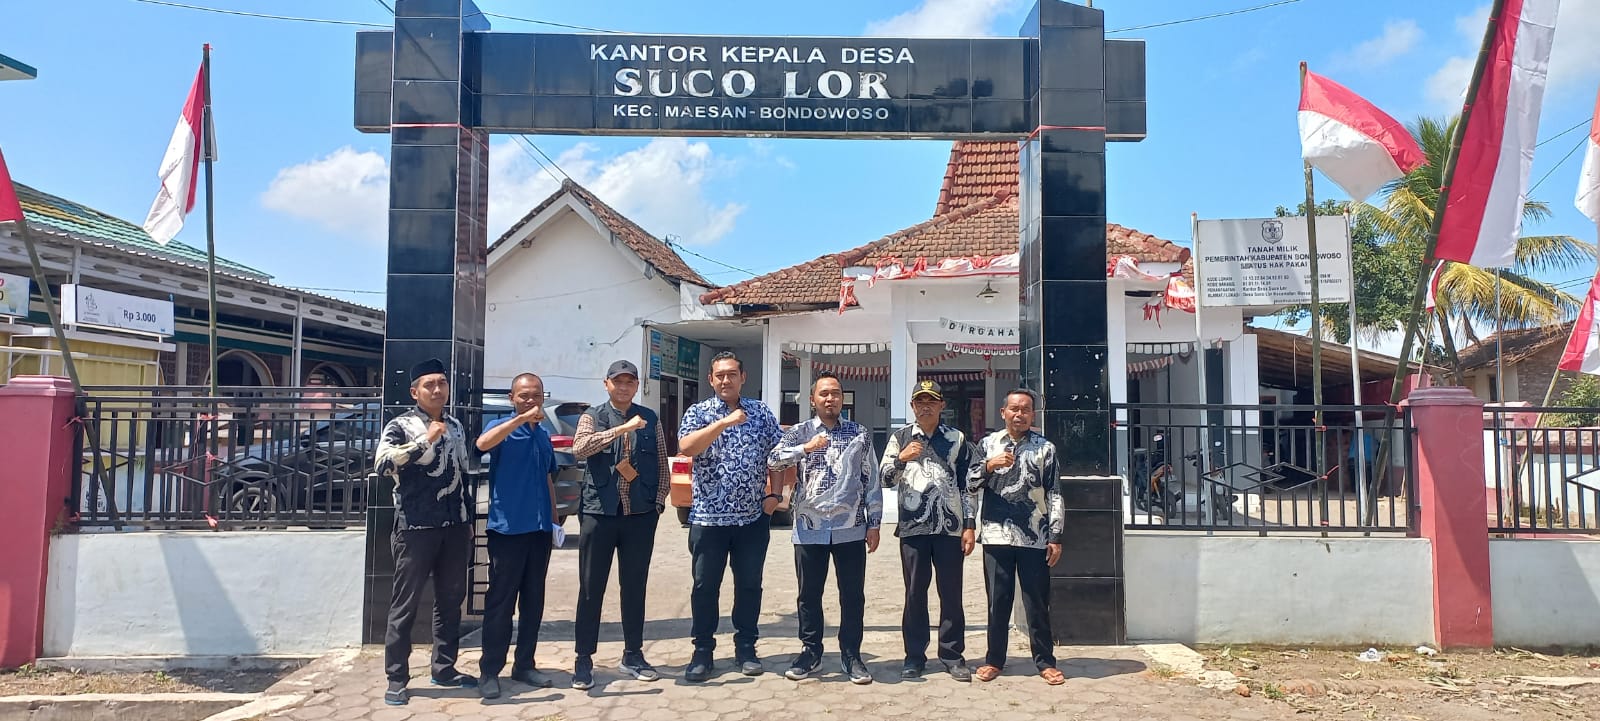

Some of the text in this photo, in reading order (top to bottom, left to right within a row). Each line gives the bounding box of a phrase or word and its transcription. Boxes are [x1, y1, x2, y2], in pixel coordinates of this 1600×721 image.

[590, 44, 915, 64] KANTOR KEPALA DESA
[613, 68, 892, 99] SUCO LOR
[613, 104, 659, 118] KEC.
[1205, 255, 1249, 263] PEMERINTAH
[1294, 252, 1342, 260] BONOWOSO
[1269, 261, 1284, 269] HAK
[1285, 260, 1308, 268] PAKAI
[123, 309, 135, 321] Rp
[135, 311, 157, 324] 3.000
[949, 321, 1020, 337] DIRGAHA
